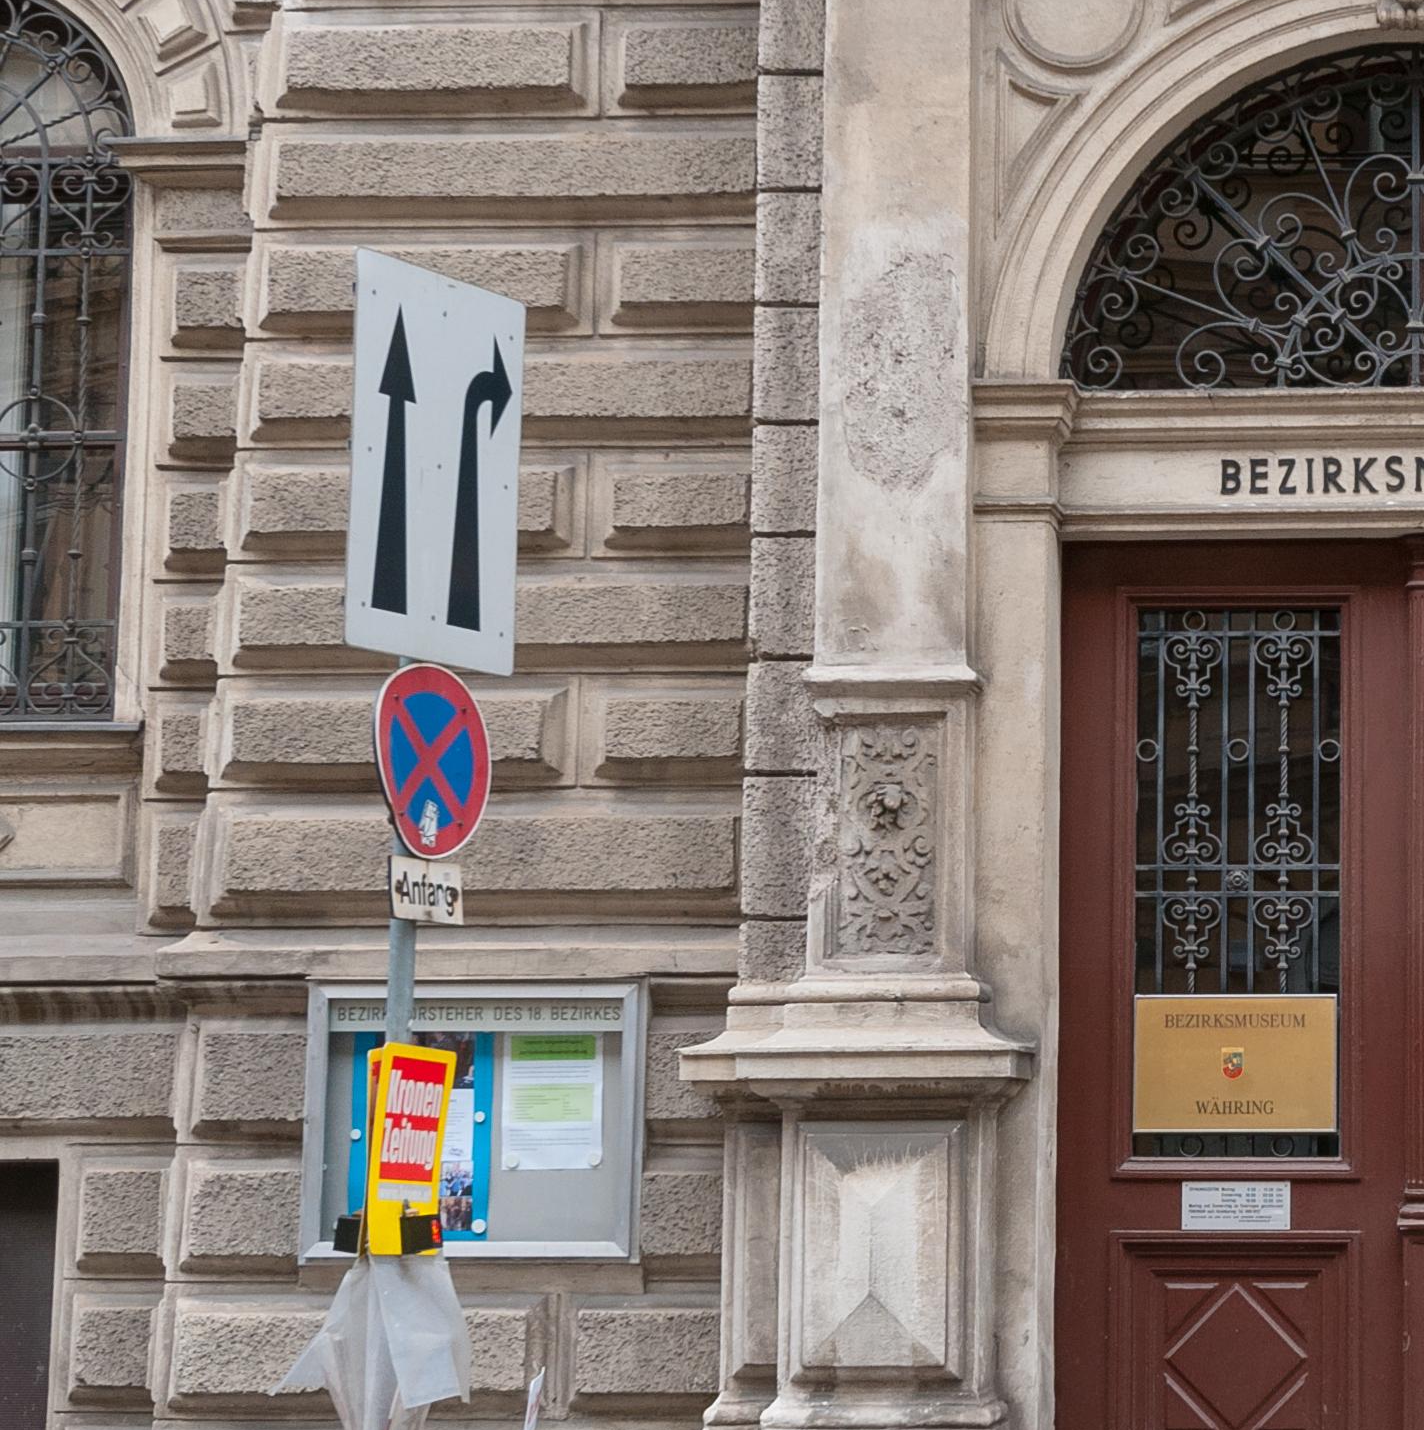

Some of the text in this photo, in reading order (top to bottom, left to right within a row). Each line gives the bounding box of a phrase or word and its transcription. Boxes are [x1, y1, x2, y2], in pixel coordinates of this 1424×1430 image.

[399, 871, 456, 917] Anfang
[337, 1006, 622, 1021] BEZIRRSTEHER DES 18. BEZIRKES
[1164, 1013, 1306, 1029] BEZIRKSMUSEUM
[385, 1069, 444, 1119] Kronen
[1195, 1096, 1275, 1115] WÄHRING
[381, 1117, 438, 1171] Zeitung
